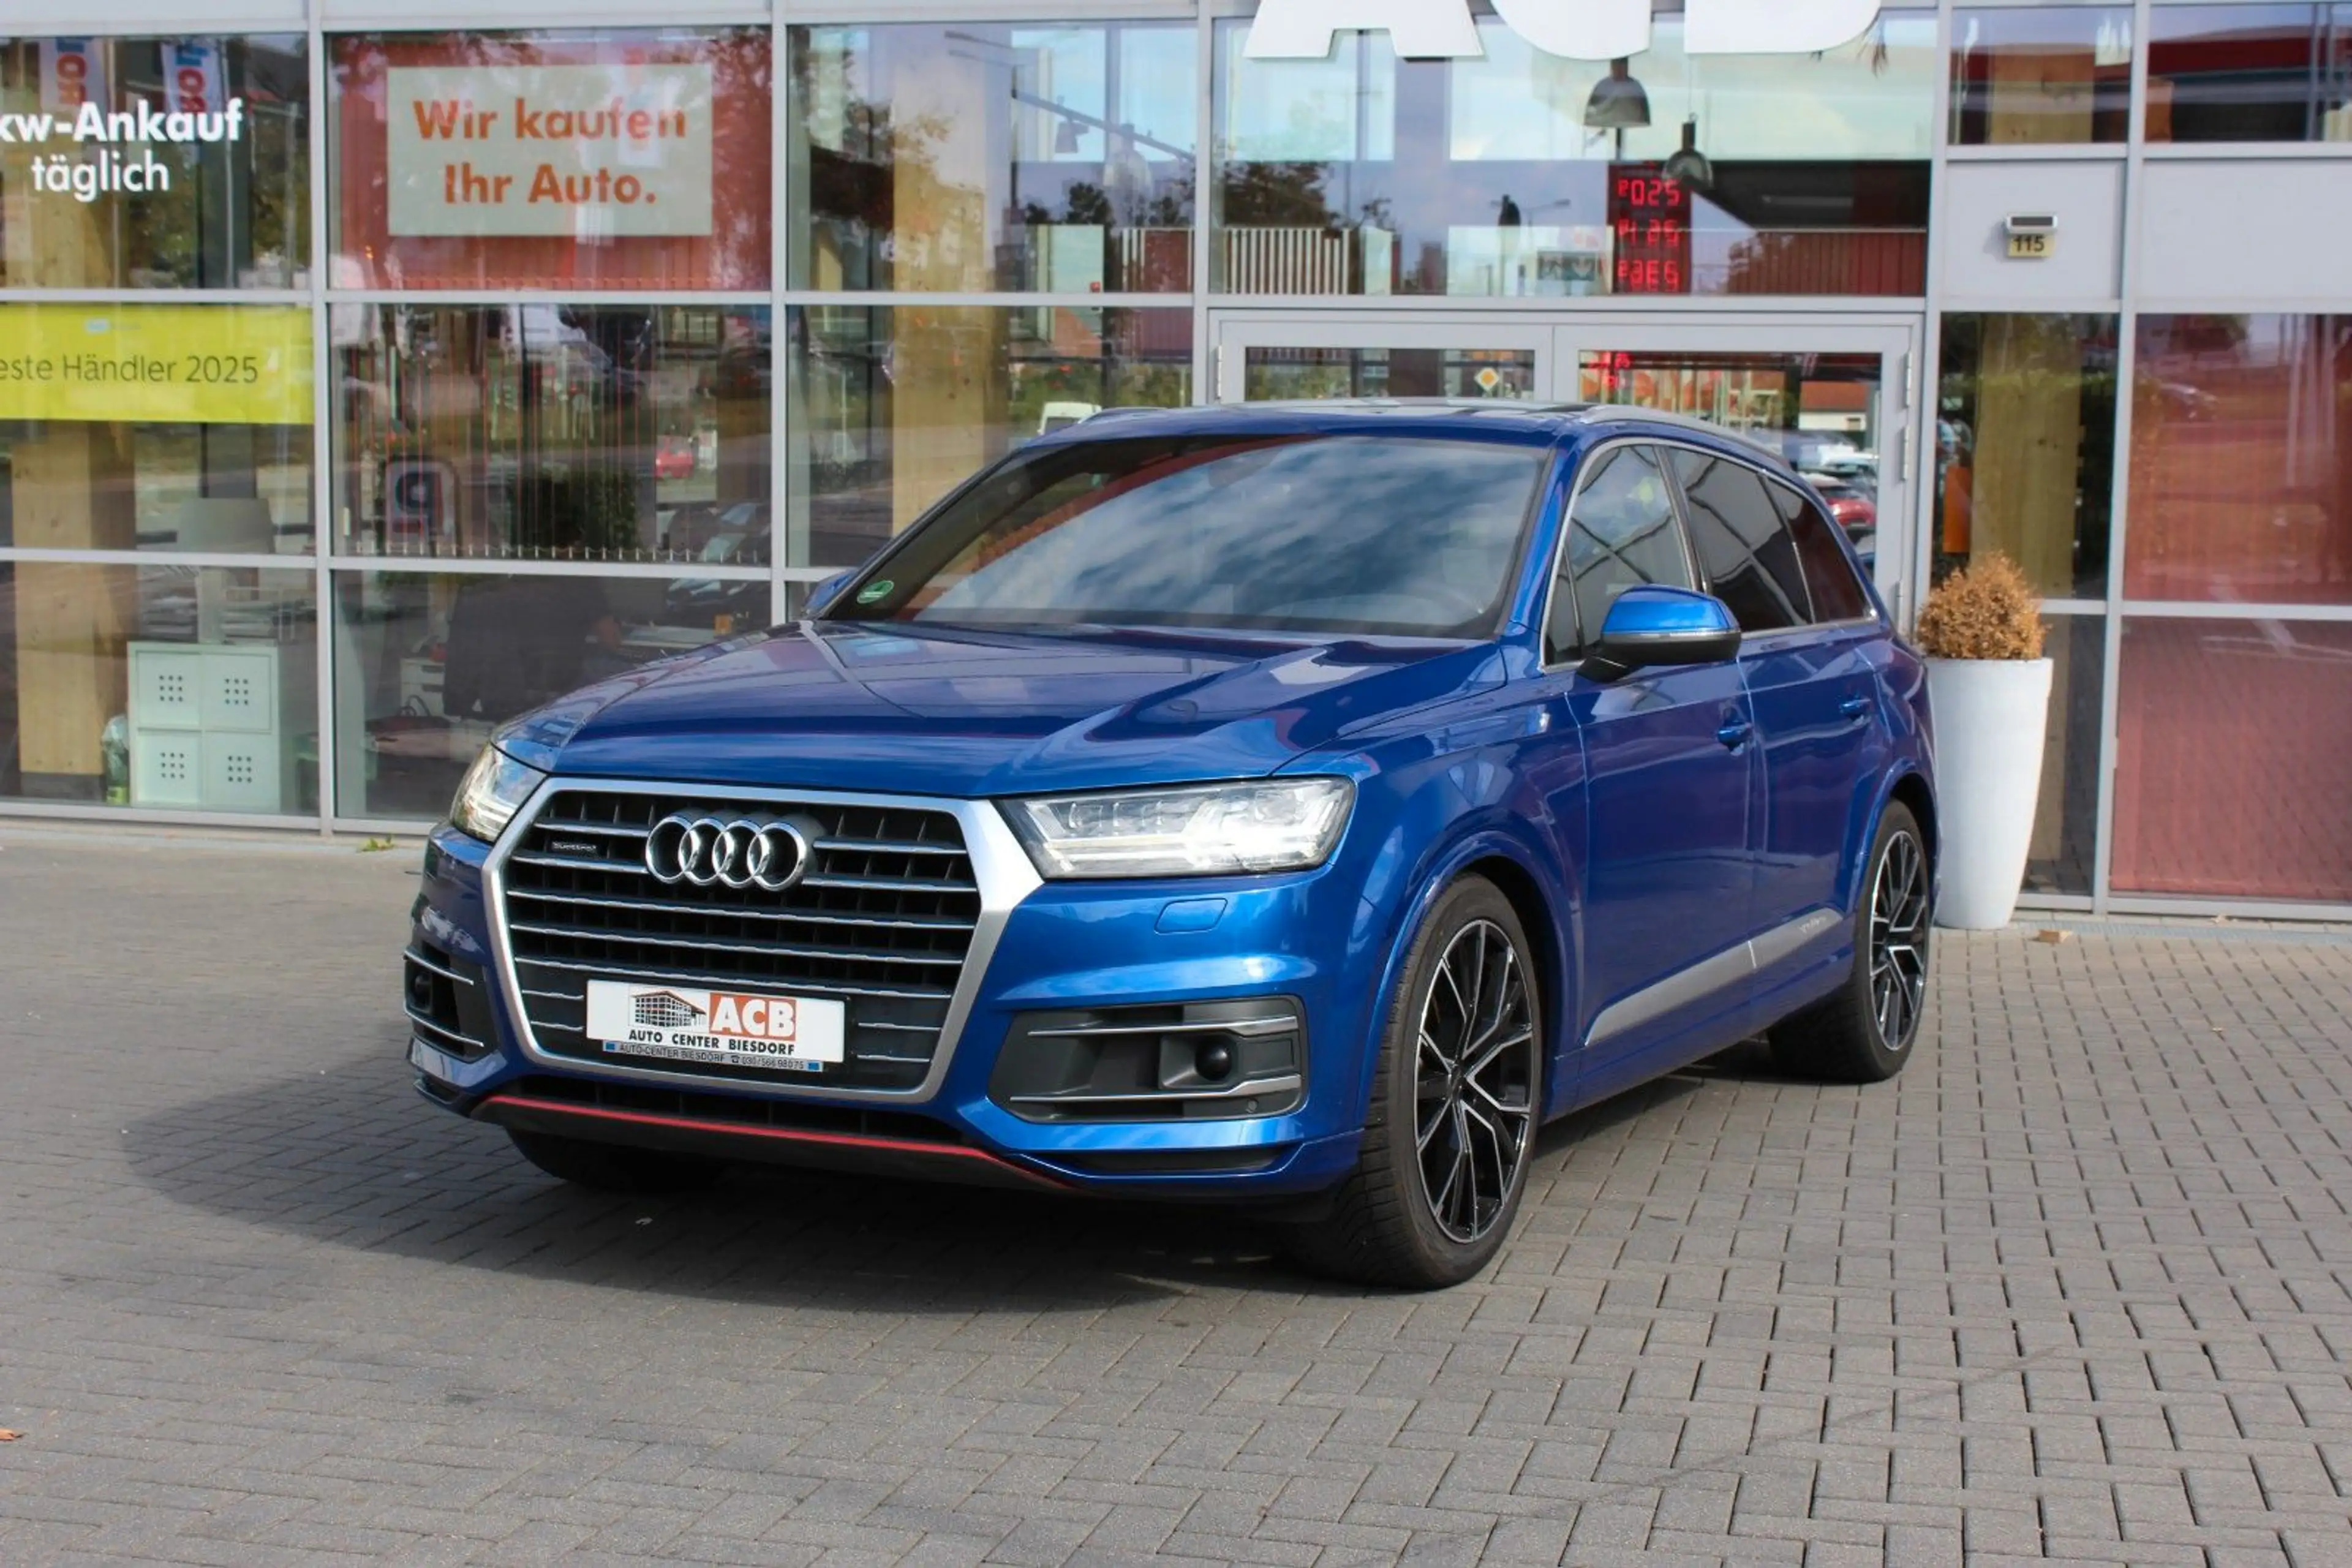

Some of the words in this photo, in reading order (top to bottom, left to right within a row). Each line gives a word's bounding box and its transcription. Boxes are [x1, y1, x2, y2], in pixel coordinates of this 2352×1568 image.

[413, 100, 497, 140] Wir
[515, 97, 687, 140] kaufen
[31, 149, 170, 203] täglich
[444, 162, 513, 204] Ihr
[528, 163, 657, 205] Auto.
[2013, 234, 2045, 252] 115
[62, 353, 177, 382] Händler
[185, 355, 258, 383] 2025
[710, 996, 794, 1037] ACB
[628, 1029, 663, 1043] AUTO
[671, 1033, 720, 1049] CENTER
[728, 1039, 794, 1055] BIESDORF
